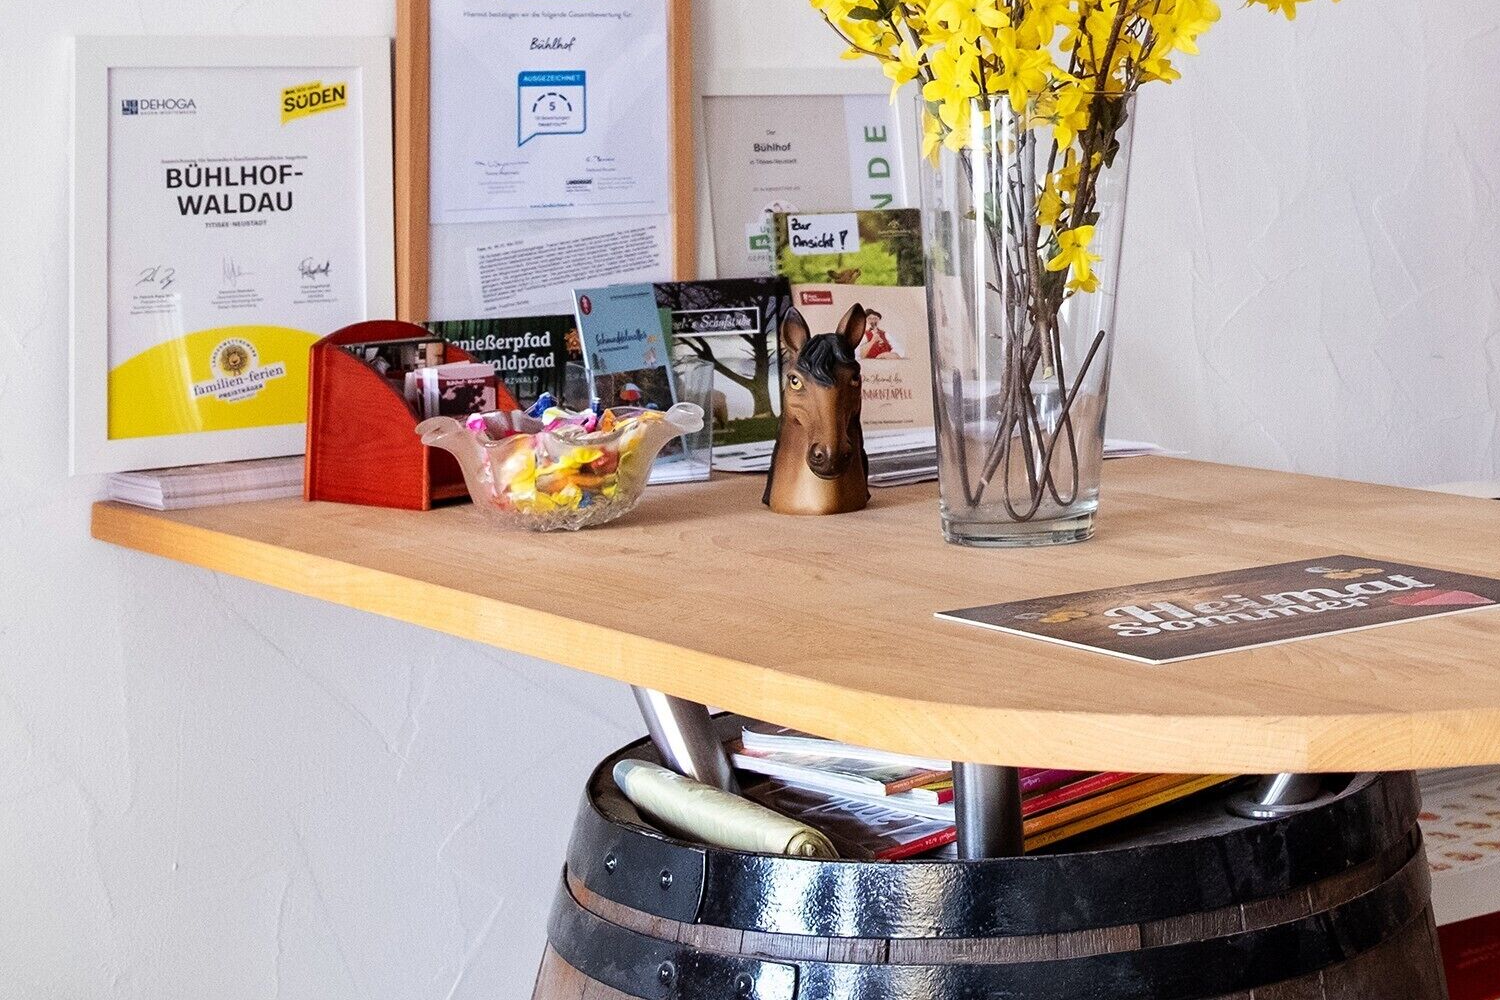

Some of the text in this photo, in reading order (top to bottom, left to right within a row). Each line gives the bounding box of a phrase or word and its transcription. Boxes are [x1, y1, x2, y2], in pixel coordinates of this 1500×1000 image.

[529, 36, 577, 52] Bühlhof
[522, 74, 582, 83] AUSGEZEICHNET
[140, 98, 197, 110] DEHOGA
[284, 85, 345, 112] SÜDEN
[549, 101, 556, 111] 5
[753, 142, 791, 152] Bühlhof
[166, 163, 303, 188] BÜHLHOF-
[177, 191, 293, 215] WALDAU
[791, 218, 812, 231] Zur
[792, 233, 835, 249] Ansicht
[446, 331, 552, 353] enießerpfad
[194, 366, 284, 396] familien-ferien
[1104, 574, 1435, 623] Heimat
[1108, 597, 1369, 637] Sommer
